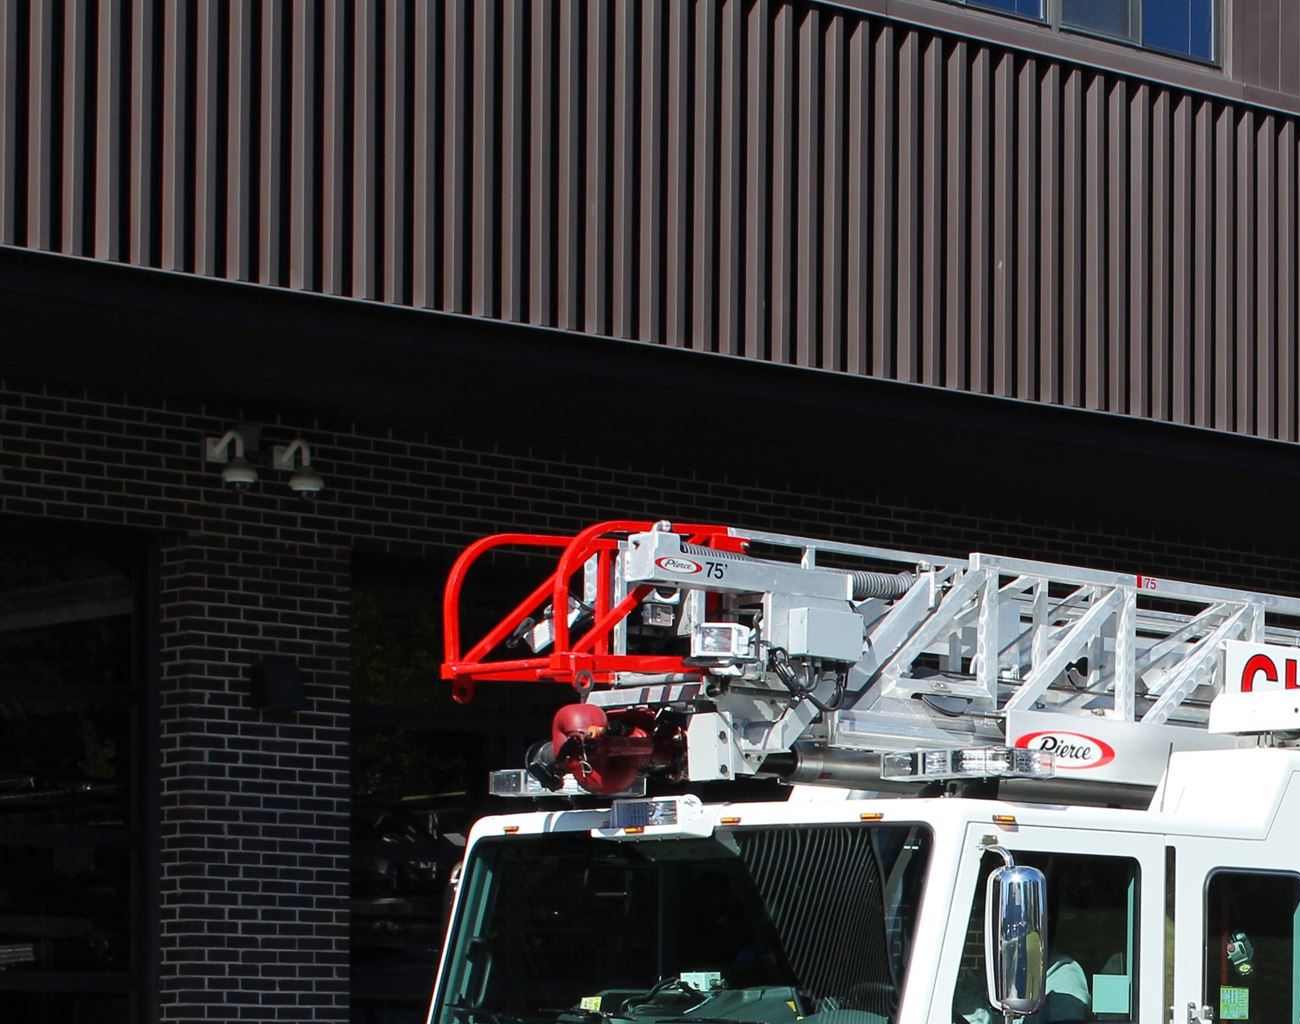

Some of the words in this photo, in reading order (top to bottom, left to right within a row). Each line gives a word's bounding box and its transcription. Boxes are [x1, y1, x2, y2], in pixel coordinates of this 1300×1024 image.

[664, 559, 693, 570] Pierce
[1145, 577, 1157, 590] 75
[1040, 735, 1092, 760] Pierce
